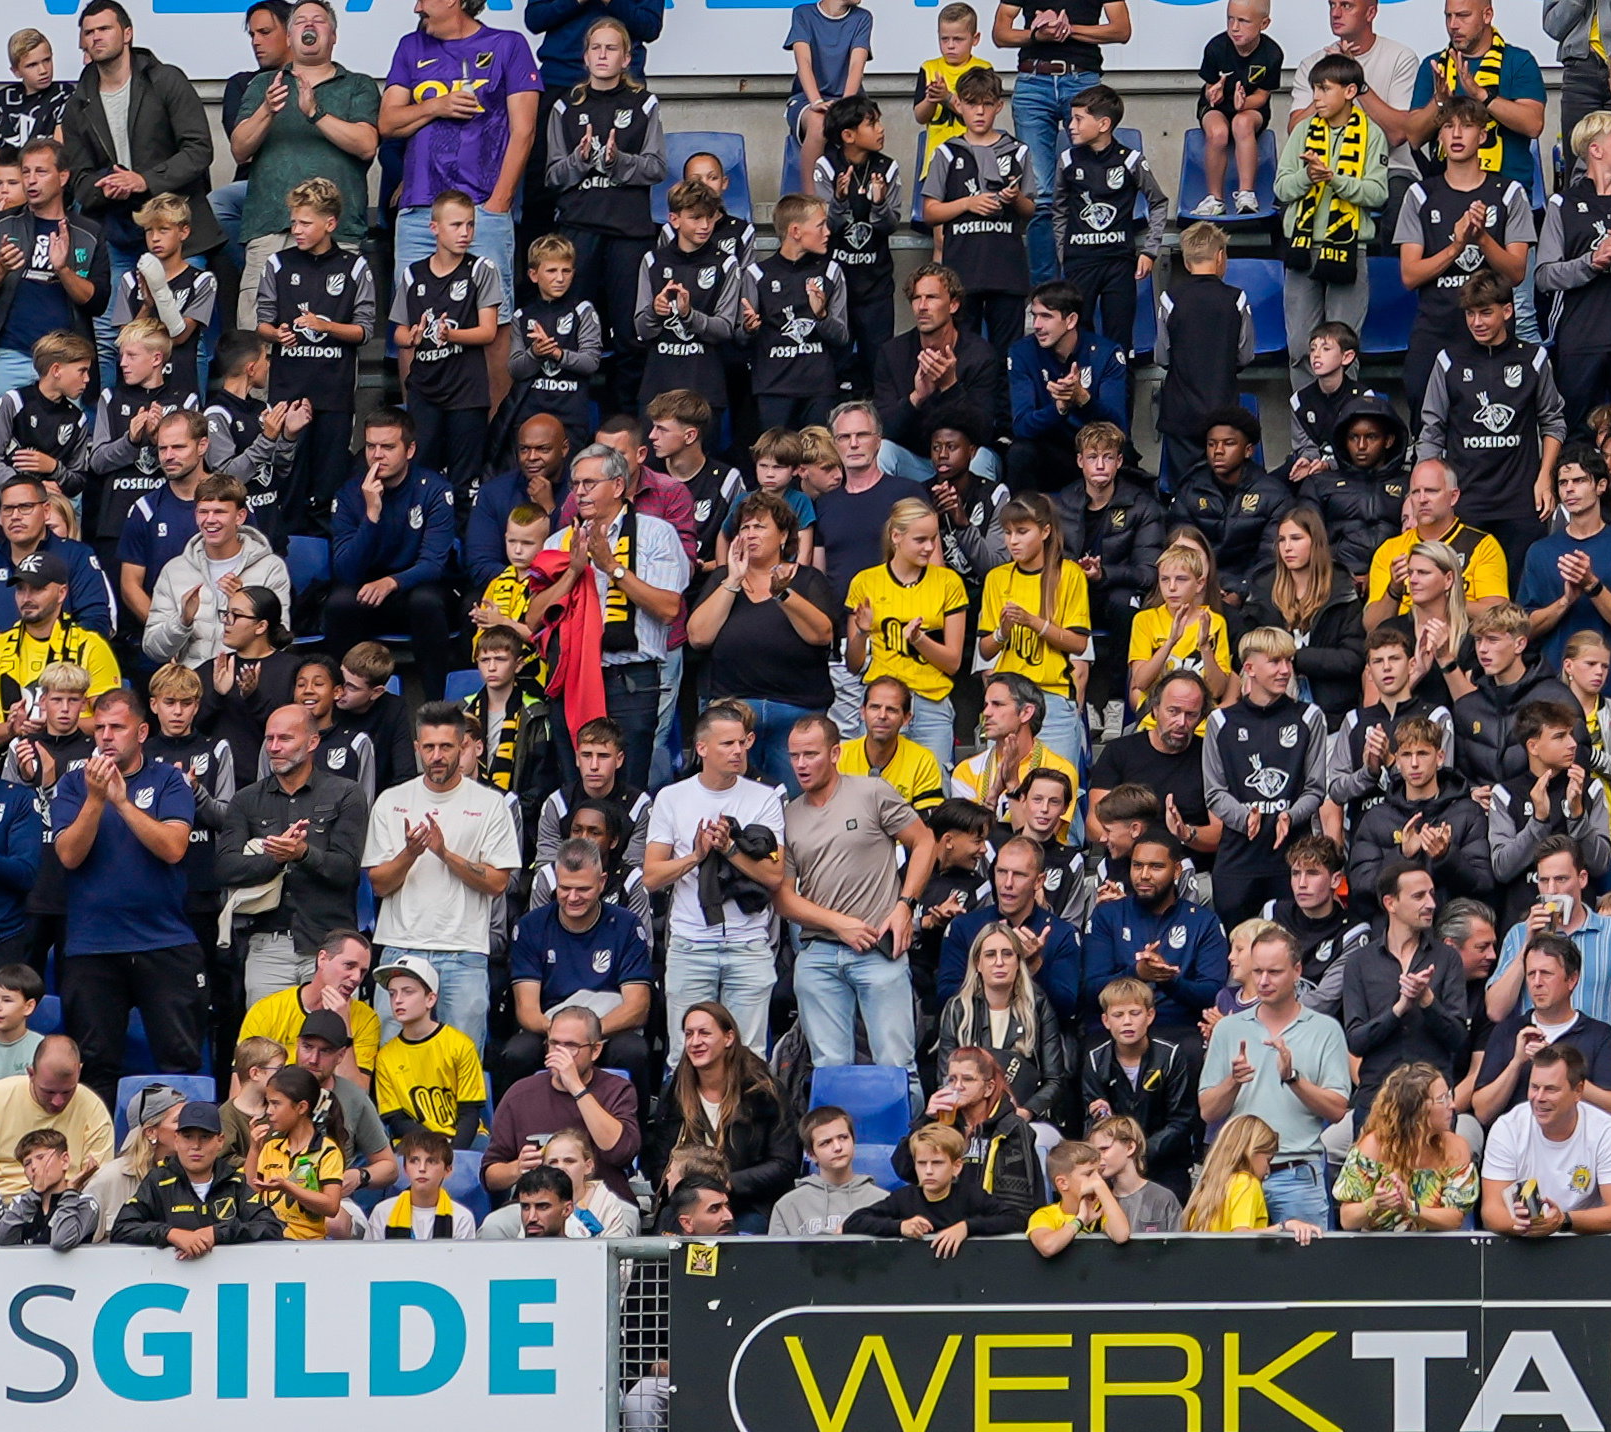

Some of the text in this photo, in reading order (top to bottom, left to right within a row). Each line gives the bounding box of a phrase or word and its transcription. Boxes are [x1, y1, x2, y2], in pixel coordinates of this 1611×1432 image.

[953, 220, 1013, 235] POSEIDON
[1070, 230, 1126, 245] POSEIDON
[280, 346, 342, 359] POSEIDON
[114, 477, 166, 491] POSEIDO
